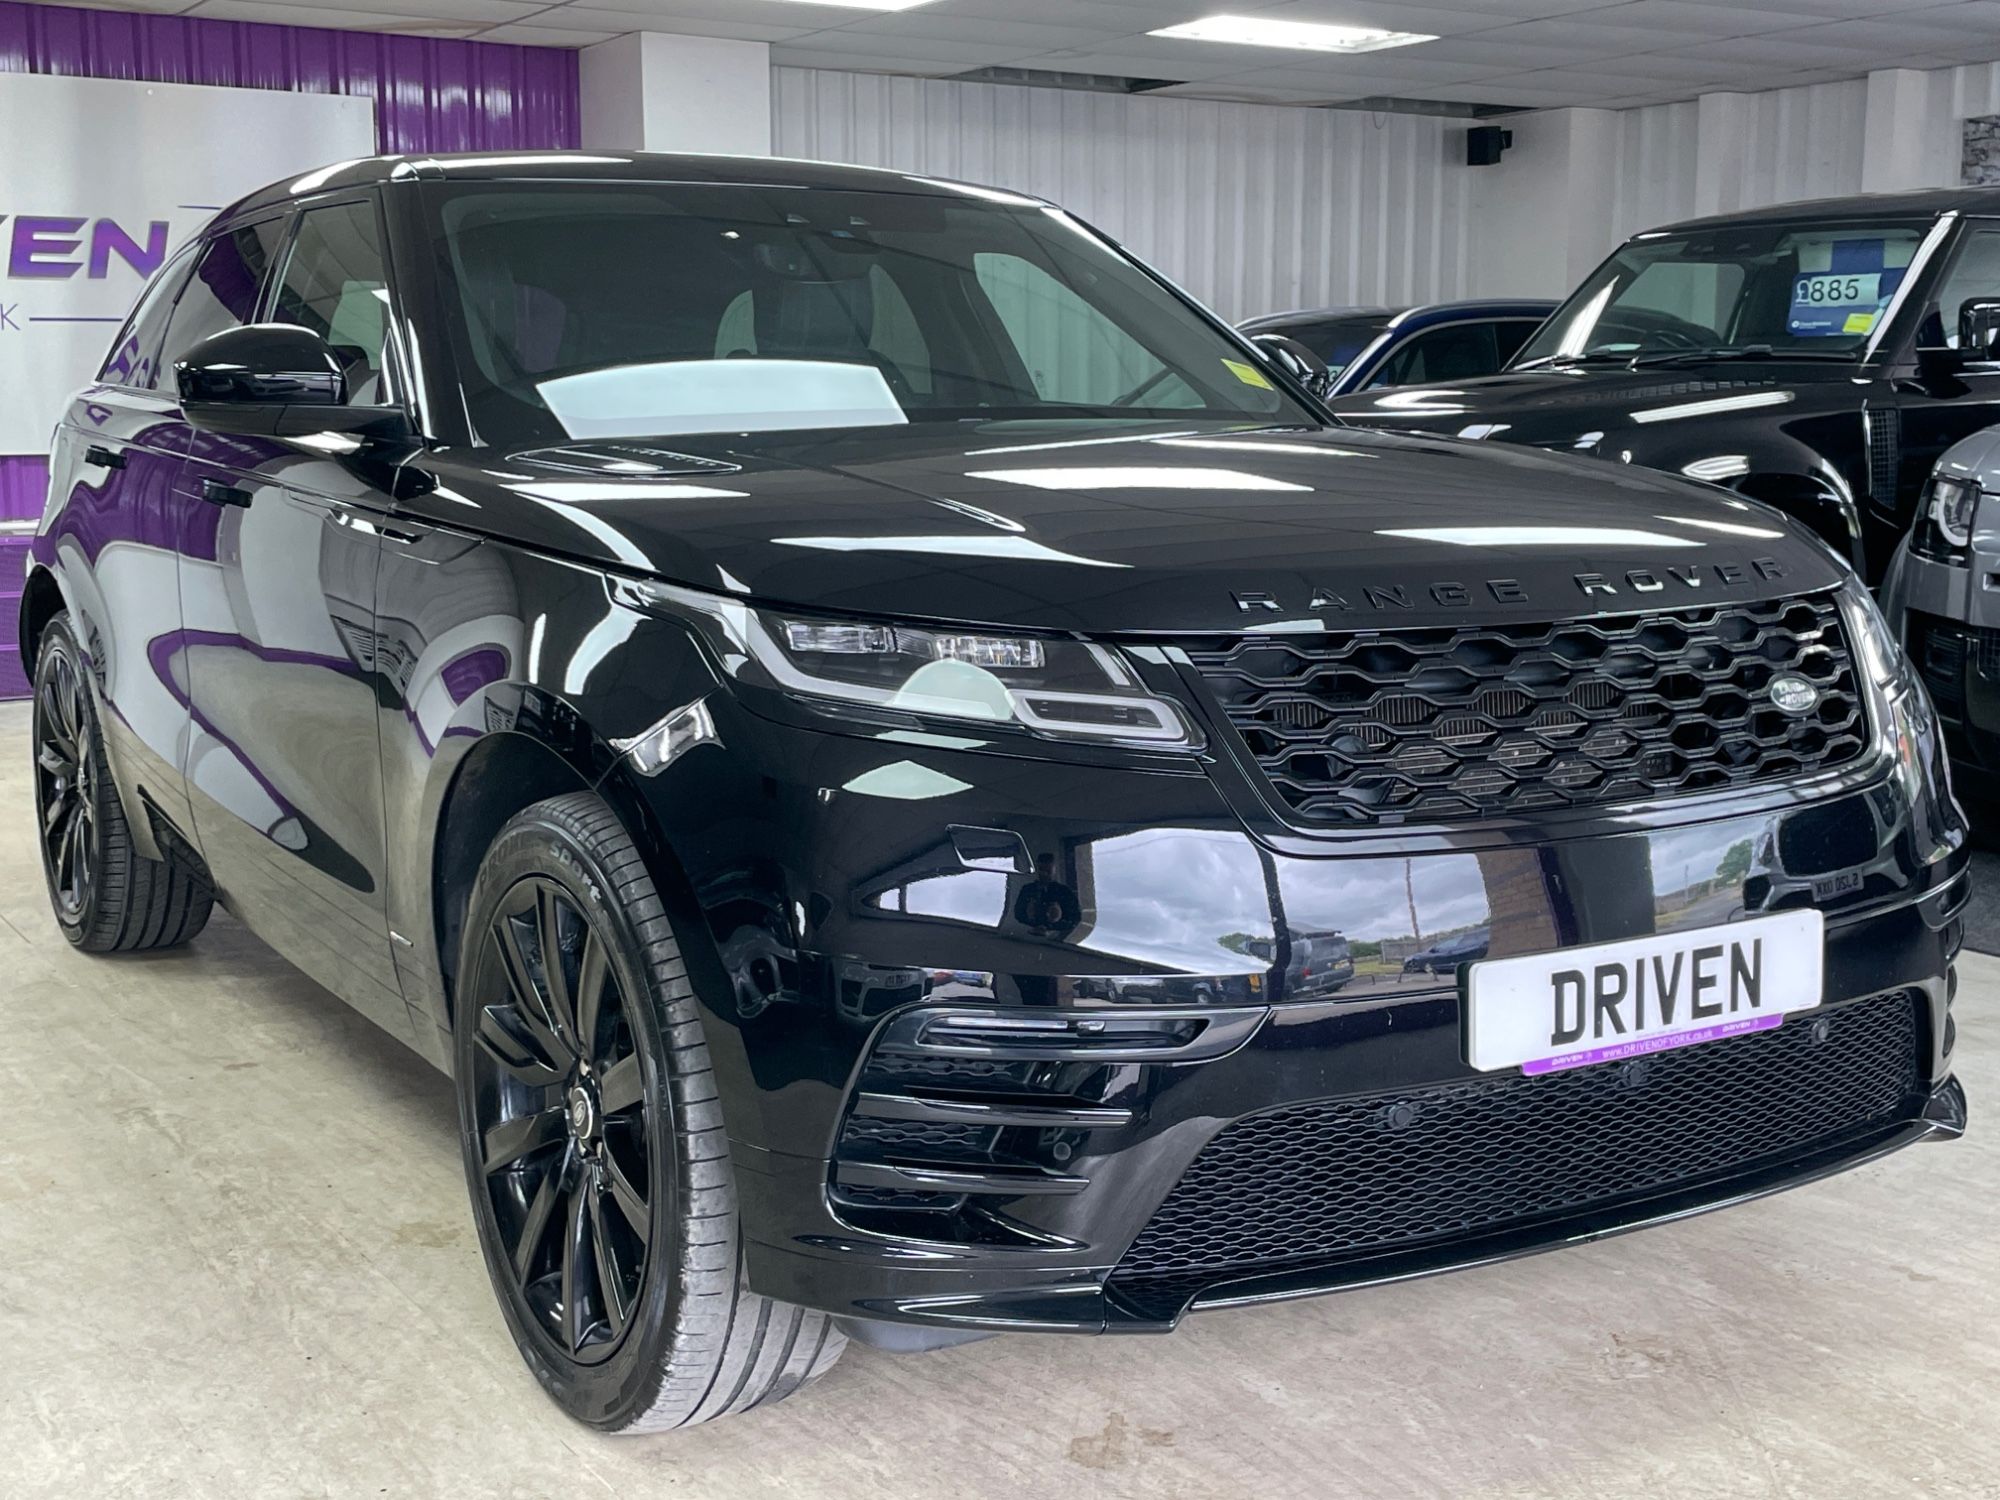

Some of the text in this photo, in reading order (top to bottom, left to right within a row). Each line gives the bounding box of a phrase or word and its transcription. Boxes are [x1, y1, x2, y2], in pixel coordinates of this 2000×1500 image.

[0, 215, 169, 281] EN
[1229, 557, 1788, 614] RANGE ROVER
[1551, 938, 1762, 1047] DRIVEN
